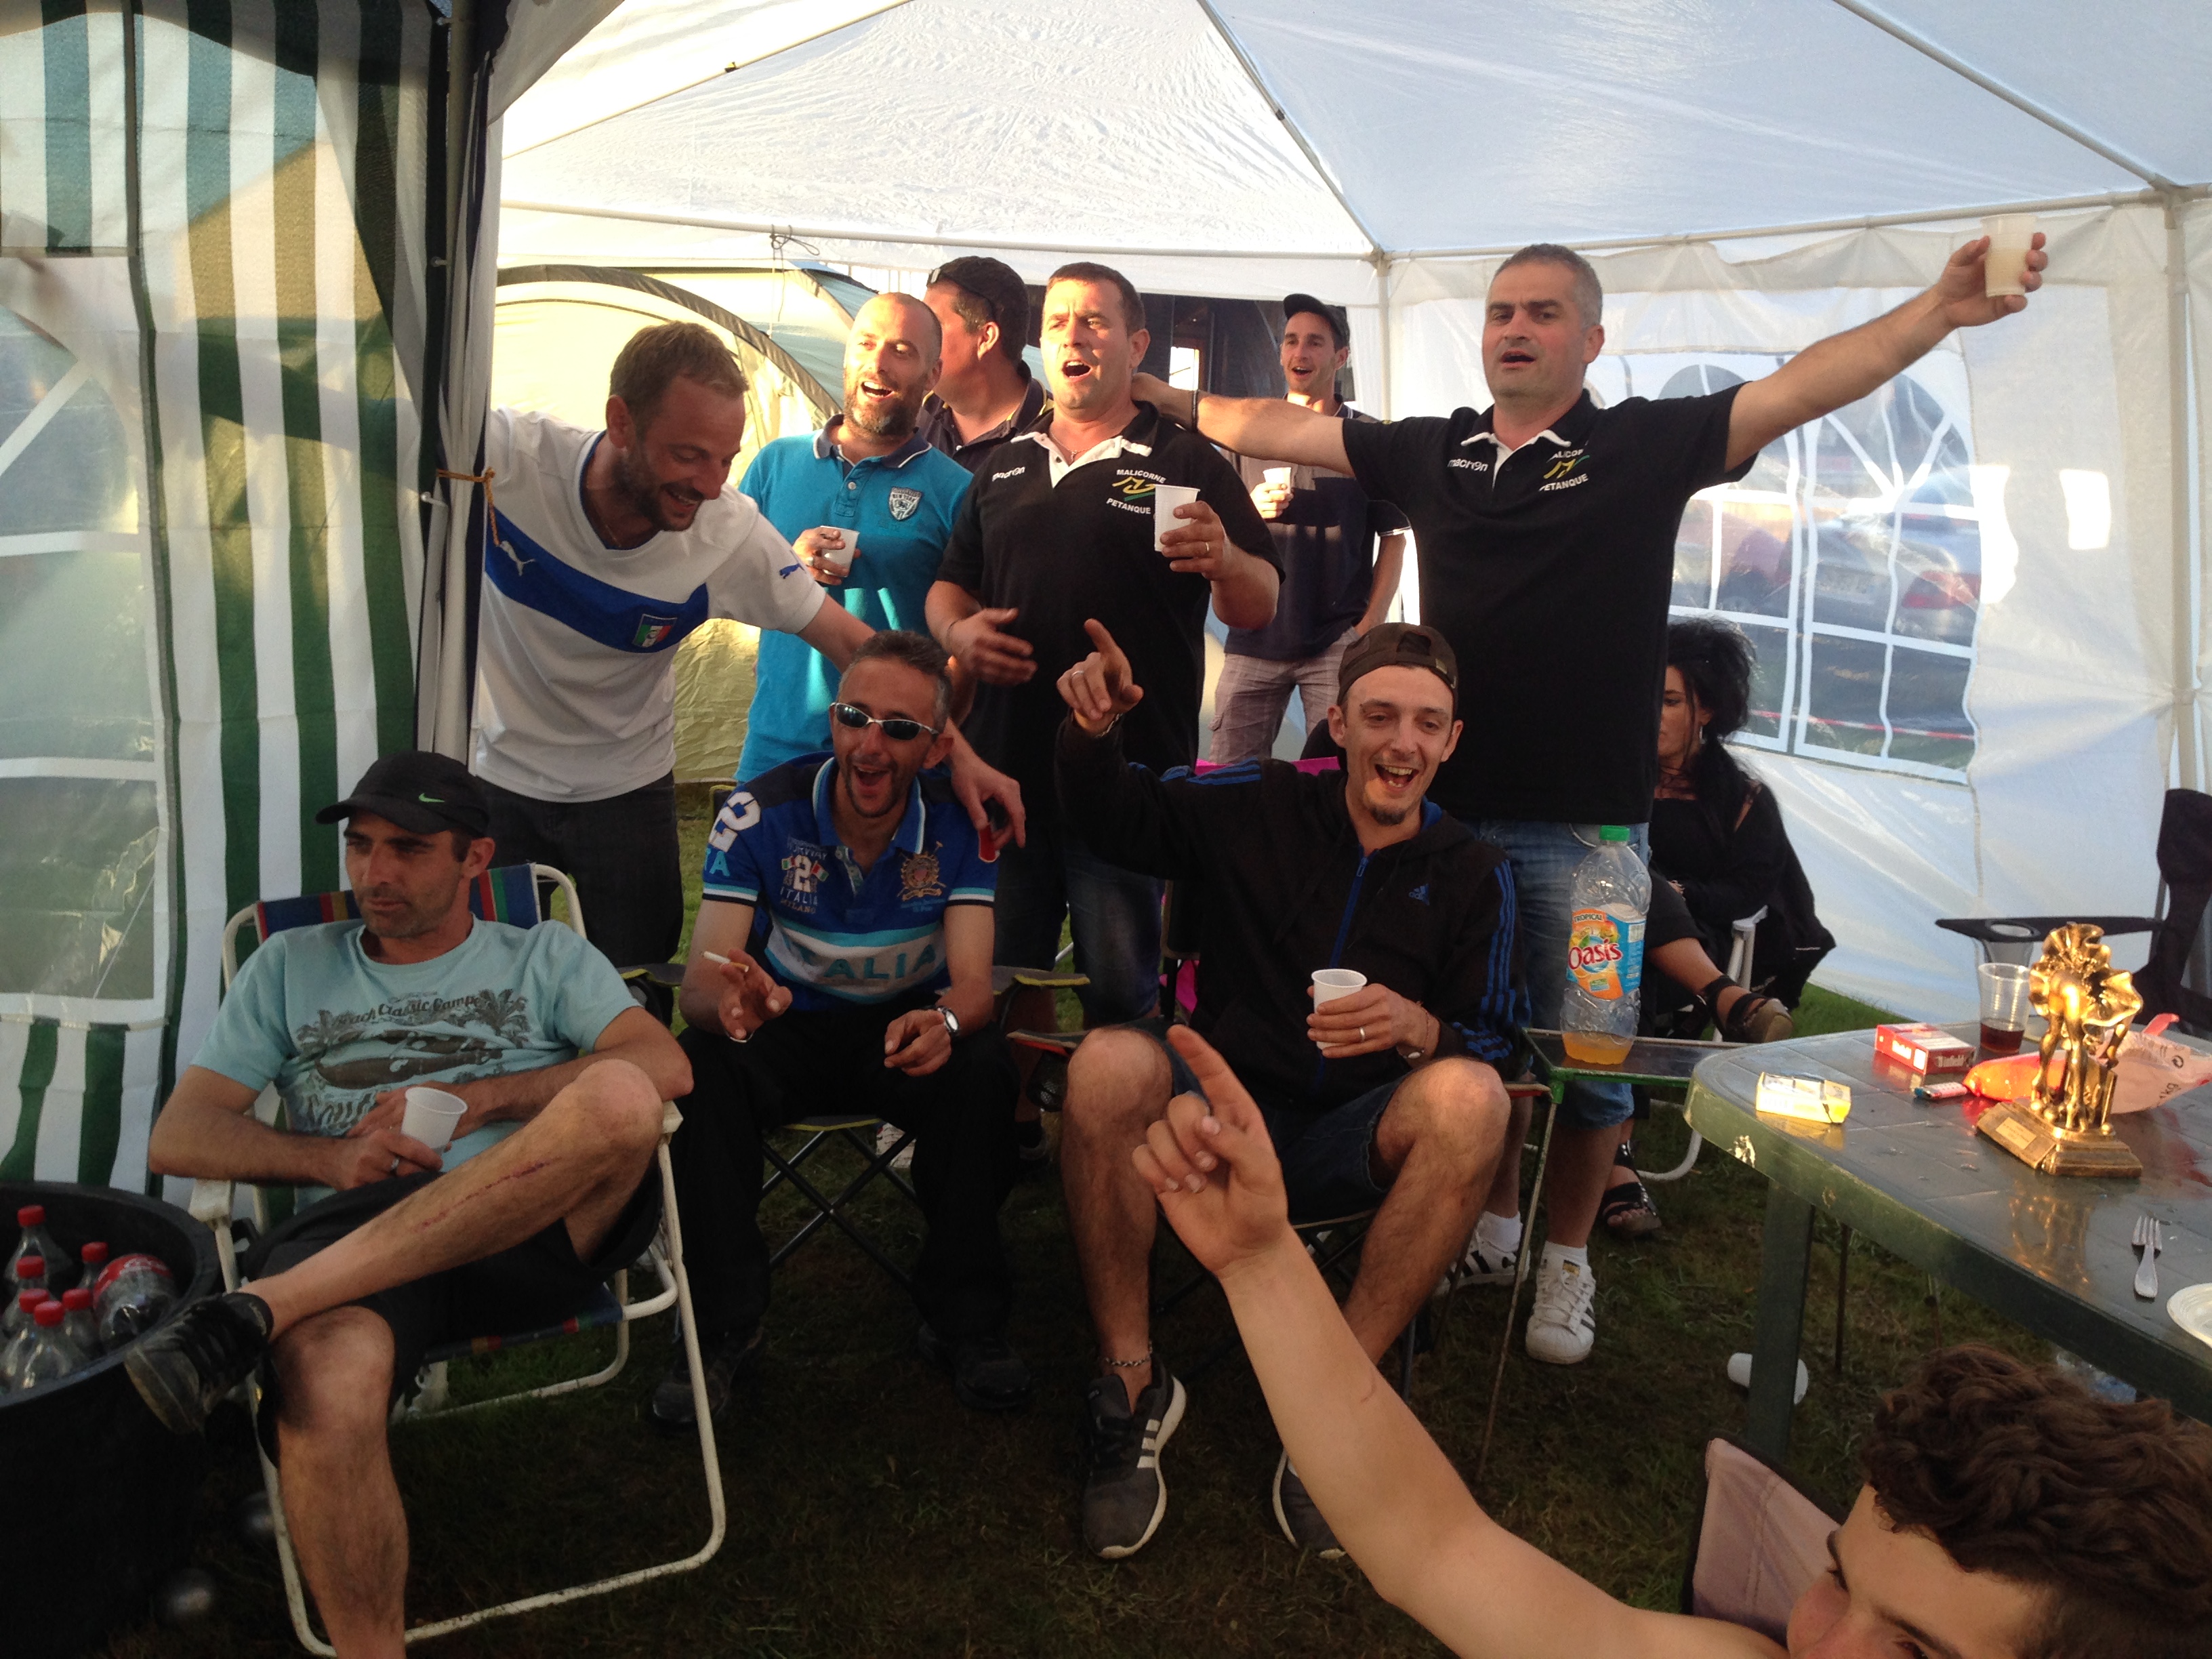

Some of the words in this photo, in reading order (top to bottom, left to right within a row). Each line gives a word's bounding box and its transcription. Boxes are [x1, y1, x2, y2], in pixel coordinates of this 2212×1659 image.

[1447, 458, 1489, 472] macron
[1116, 469, 1166, 484] MALICORNE
[1106, 497, 1151, 514] PETANQUE
[708, 792, 761, 853] 2
[794, 855, 812, 893] 2
[780, 886, 818, 906] ITALIA
[1574, 914, 1603, 922] TROPICAL
[1568, 938, 1623, 970] Oasis
[377, 1000, 430, 1017] Classic
